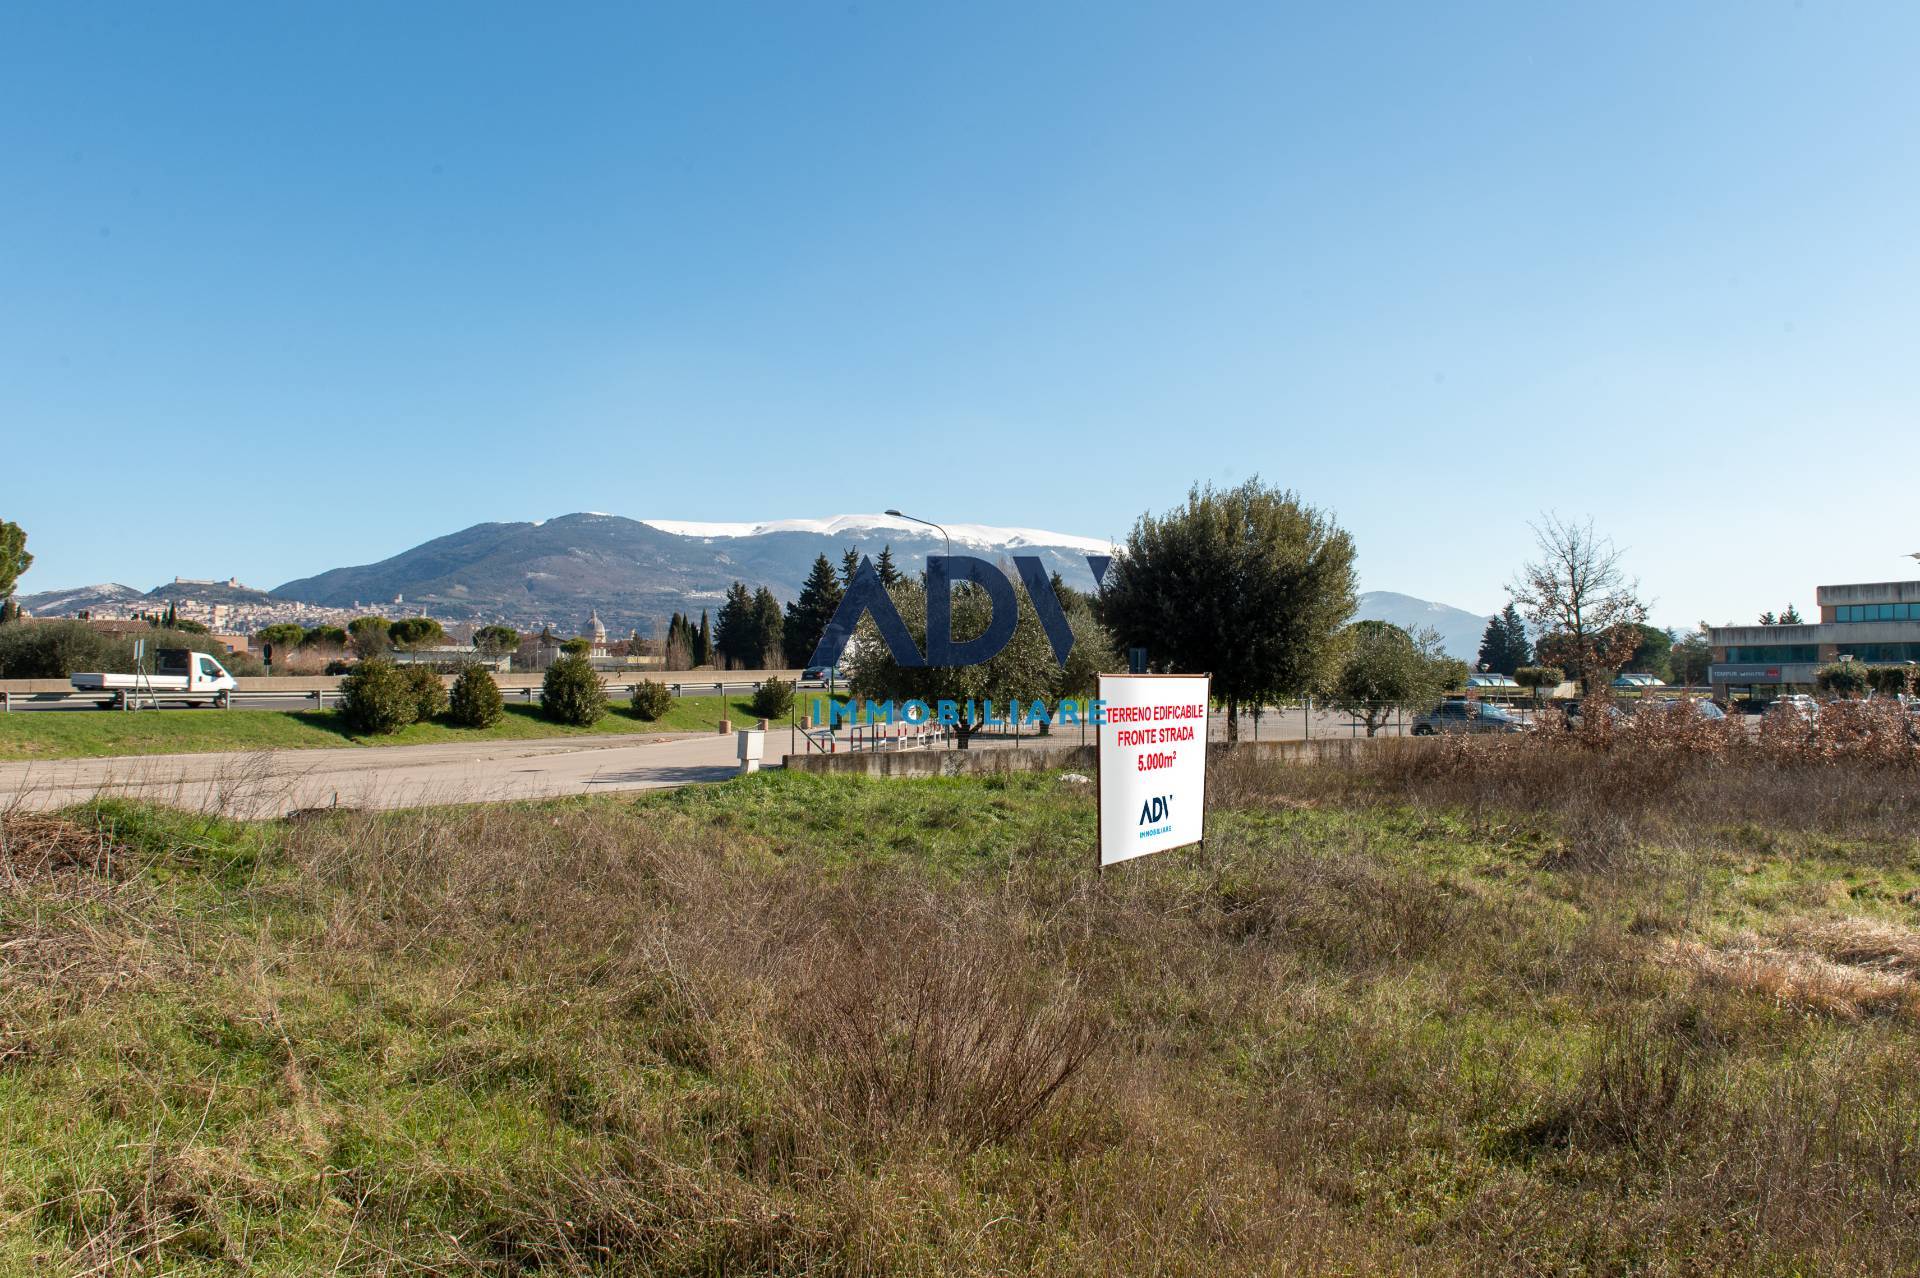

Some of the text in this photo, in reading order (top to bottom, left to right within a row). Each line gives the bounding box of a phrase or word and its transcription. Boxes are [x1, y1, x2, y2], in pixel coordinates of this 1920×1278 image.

[1106, 704, 1203, 723] TERRENO EDIFICABILE
[1117, 726, 1194, 747] FRONTE STRADA
